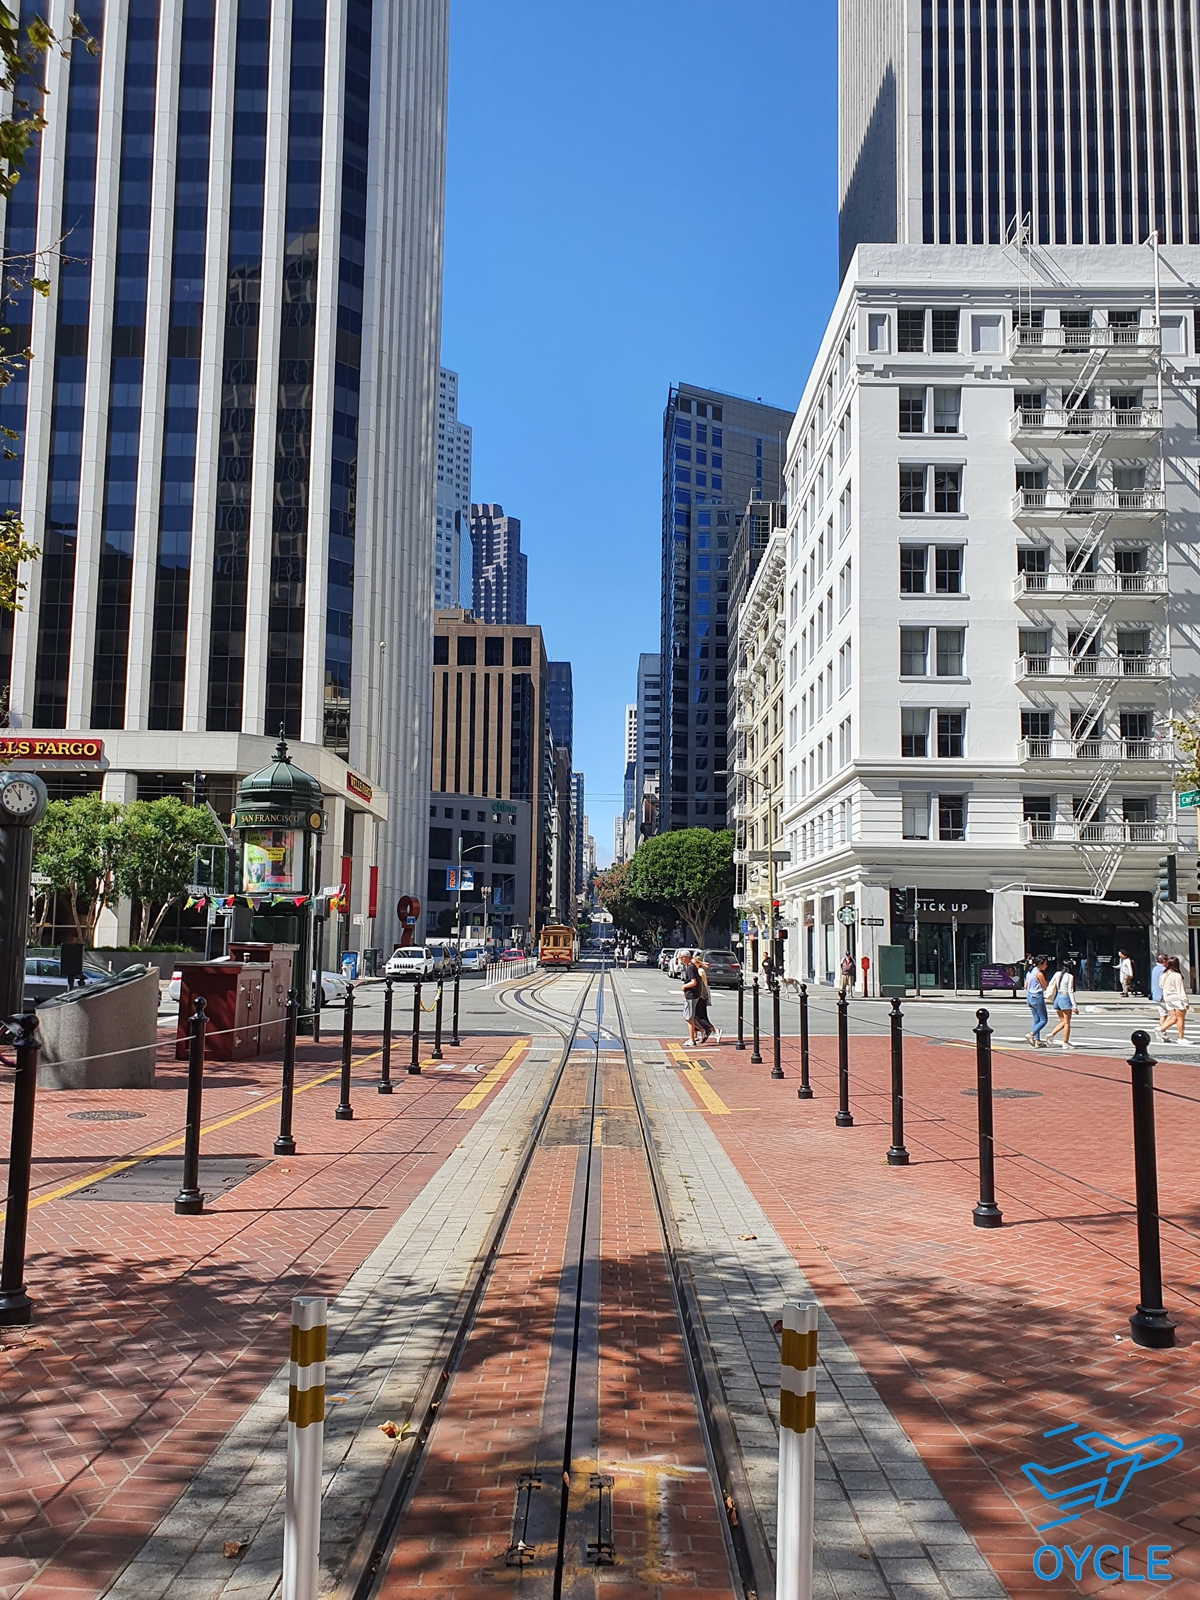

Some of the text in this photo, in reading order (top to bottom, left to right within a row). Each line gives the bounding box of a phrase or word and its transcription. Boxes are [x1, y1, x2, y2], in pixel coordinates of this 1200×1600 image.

[34, 742, 98, 756] FARGO
[492, 801, 517, 814] chime
[241, 814, 300, 823] SAN FRANCISCO
[914, 903, 969, 912] PICK UP
